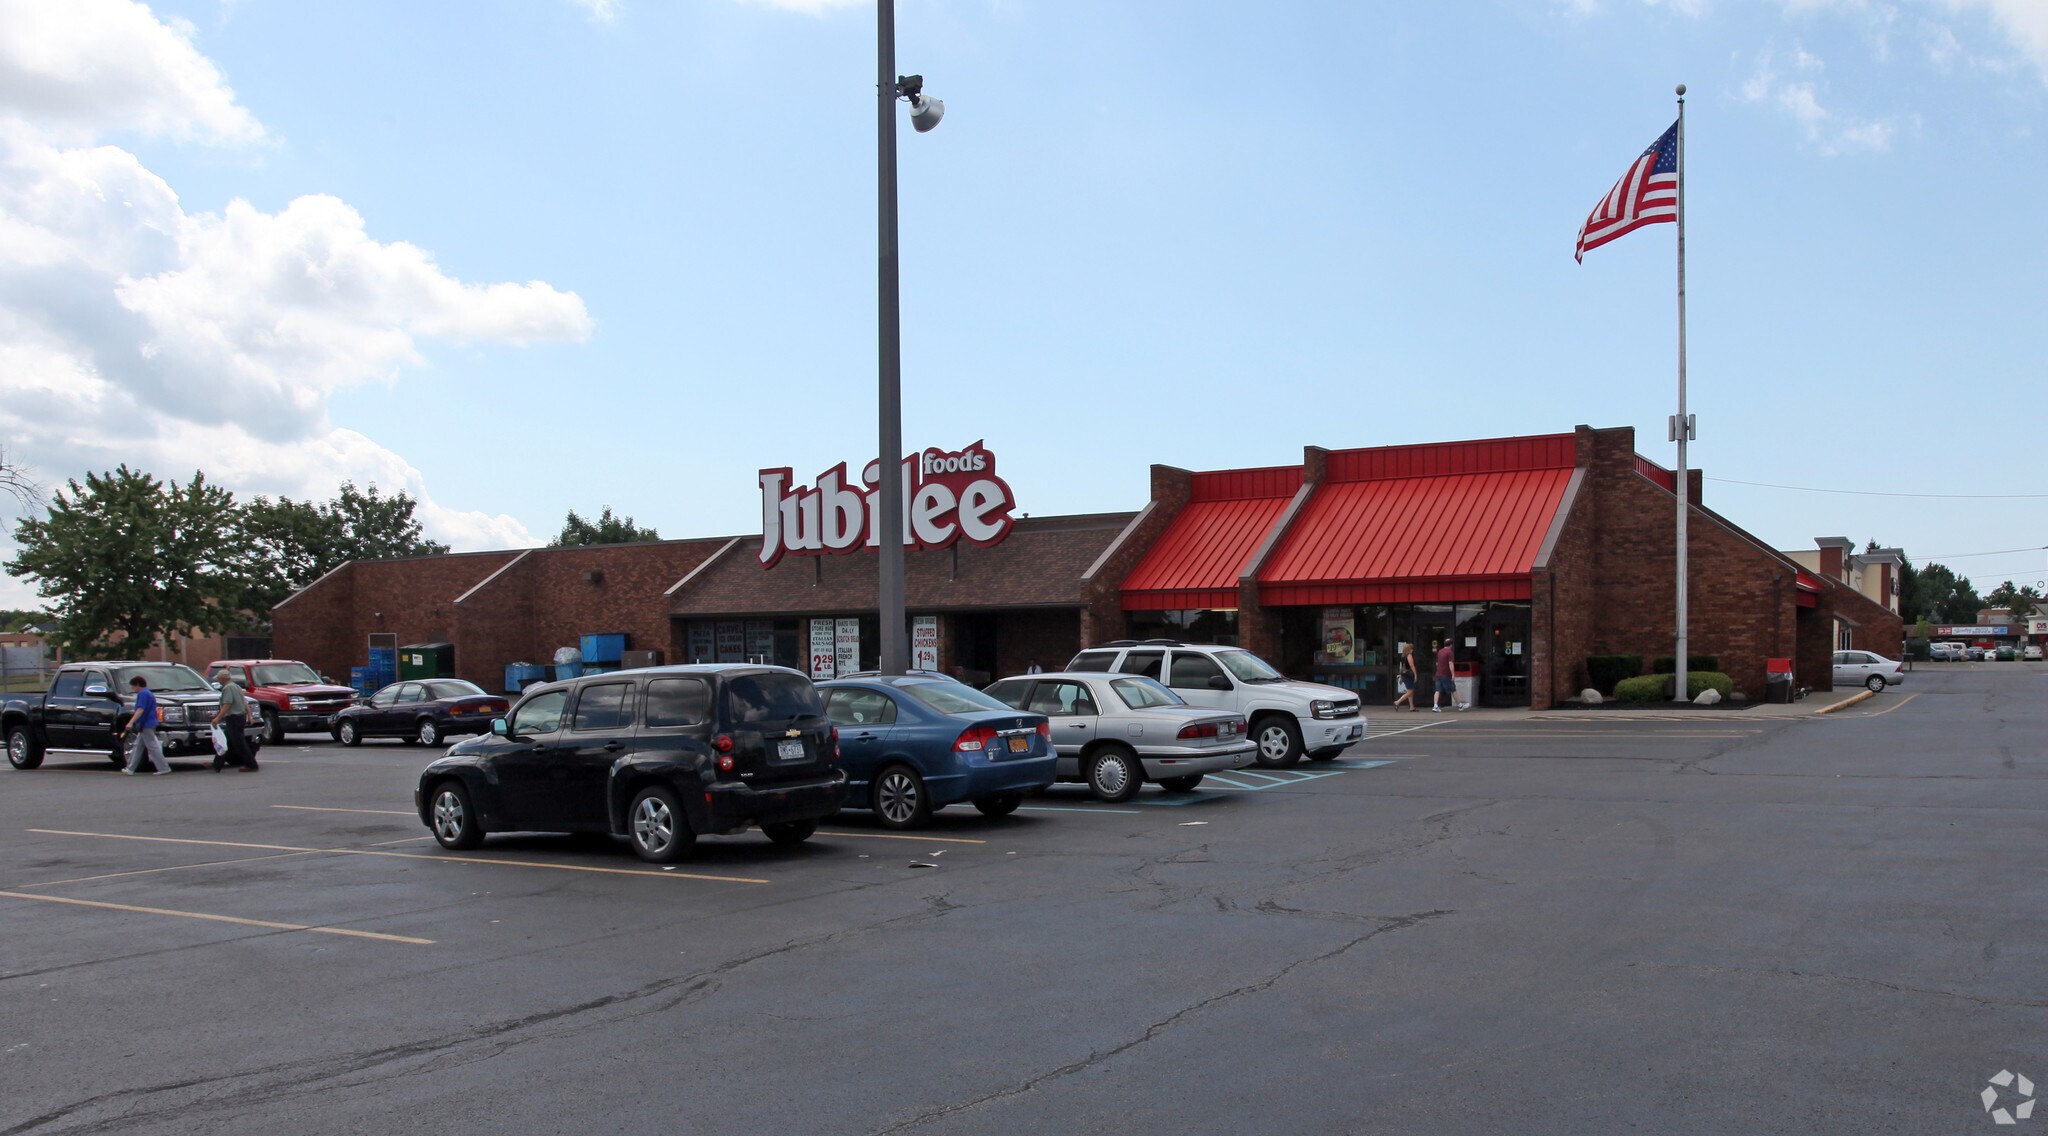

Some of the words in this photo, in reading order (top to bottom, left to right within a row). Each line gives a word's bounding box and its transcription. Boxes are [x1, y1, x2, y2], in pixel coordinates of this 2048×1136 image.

[925, 451, 985, 474] foods
[917, 628, 935, 637] STUFFED
[915, 638, 937, 647] CHICKENS
[720, 645, 741, 653] CAKES
